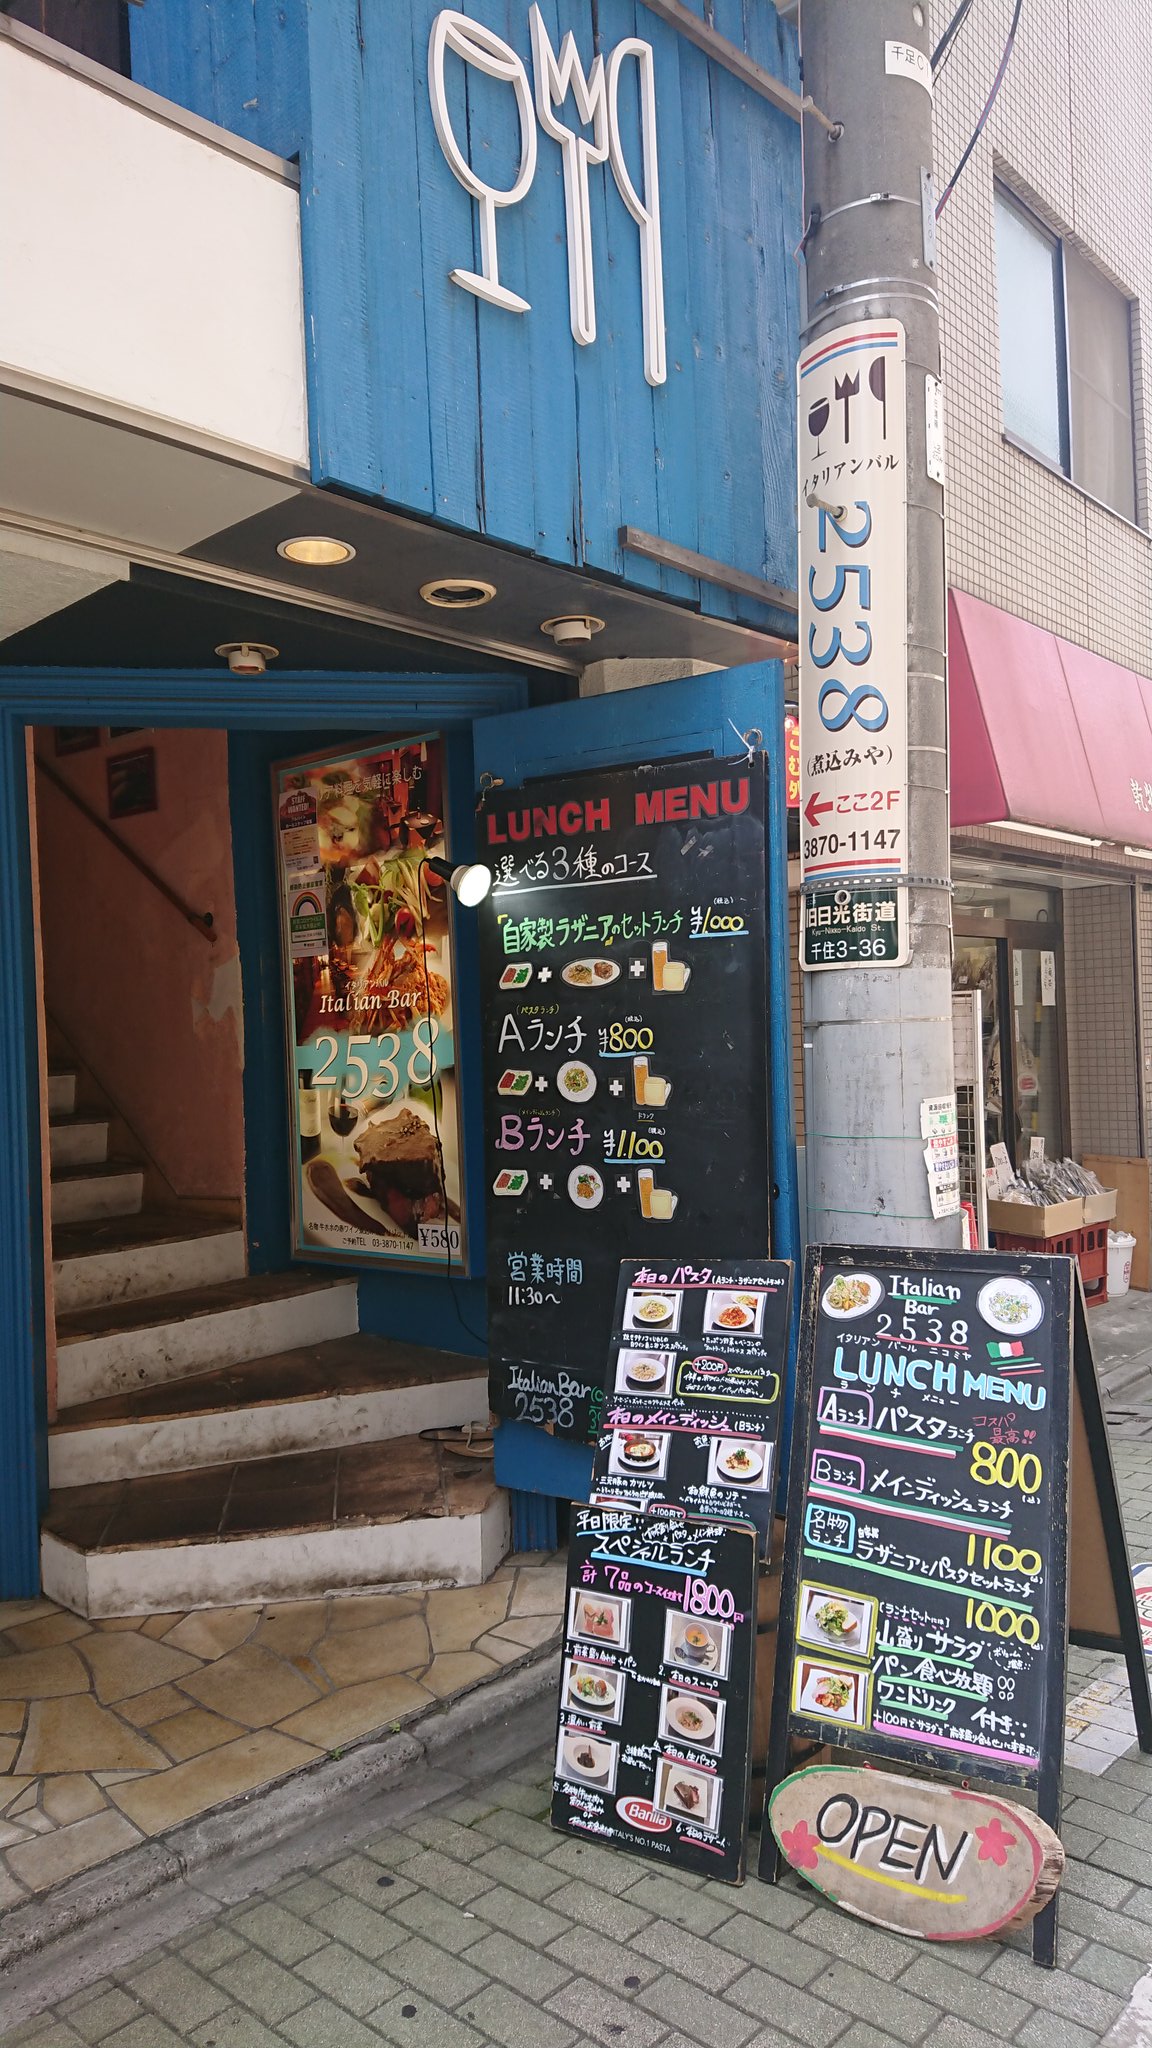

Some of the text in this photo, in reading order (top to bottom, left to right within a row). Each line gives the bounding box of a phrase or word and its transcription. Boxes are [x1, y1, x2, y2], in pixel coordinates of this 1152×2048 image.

[803, 455, 899, 497] イタリアンバル
[809, 501, 889, 732] 2538
[807, 745, 893, 777] (煮込みや)
[487, 777, 751, 845] LUNCH MENU
[837, 790, 901, 814] ここ2F
[803, 829, 901, 859] 3870-1147
[493, 844, 654, 887] 選べる3種のコース
[806, 901, 896, 929] 旧日光街道
[812, 924, 885, 937] Kyu-Nikko-Kaido St.
[811, 938, 886, 960] 千住3-36
[319, 989, 421, 1014] Italian Bar
[498, 1013, 587, 1054] Aランチ
[598, 1022, 654, 1054] ¥800
[311, 1017, 439, 1099] 2538
[495, 1114, 591, 1155] Bランチ
[372, 1240, 414, 1249] 03-3870-1147
[419, 1228, 459, 1249] ¥580
[507, 1251, 583, 1285] 営業時間
[887, 1275, 961, 1300] Italian
[905, 1300, 939, 1316] Bar
[875, 1313, 970, 1346] 2538
[836, 1333, 973, 1361] イタリアン バール ニコミヤ
[694, 1360, 724, 1372] +200円
[833, 1346, 1046, 1411] LUNCH MENU
[515, 1392, 575, 1428] 2538
[922, 1393, 960, 1405] メニュー
[822, 1393, 975, 1444] Aランチ パスタランチ
[972, 1412, 1016, 1428] コスパ
[970, 1441, 1042, 1494] 800
[816, 1458, 1014, 1519] Bランチ メインディッシュランチ
[809, 1510, 849, 1535] 名物
[811, 1530, 846, 1548] ランチ
[593, 1534, 716, 1573] スペシャルランチ
[855, 1539, 1035, 1598] ラザニアとパスタセットランチ
[967, 1533, 1042, 1576] 1100
[966, 1597, 1040, 1645] 1000
[875, 1619, 992, 1663] 山盛りサラダ
[877, 1680, 957, 1715] ワンドリンク
[634, 1835, 650, 1847] NO.1
[651, 1841, 671, 1853] PASTA
[816, 1793, 974, 1885] OPEN
